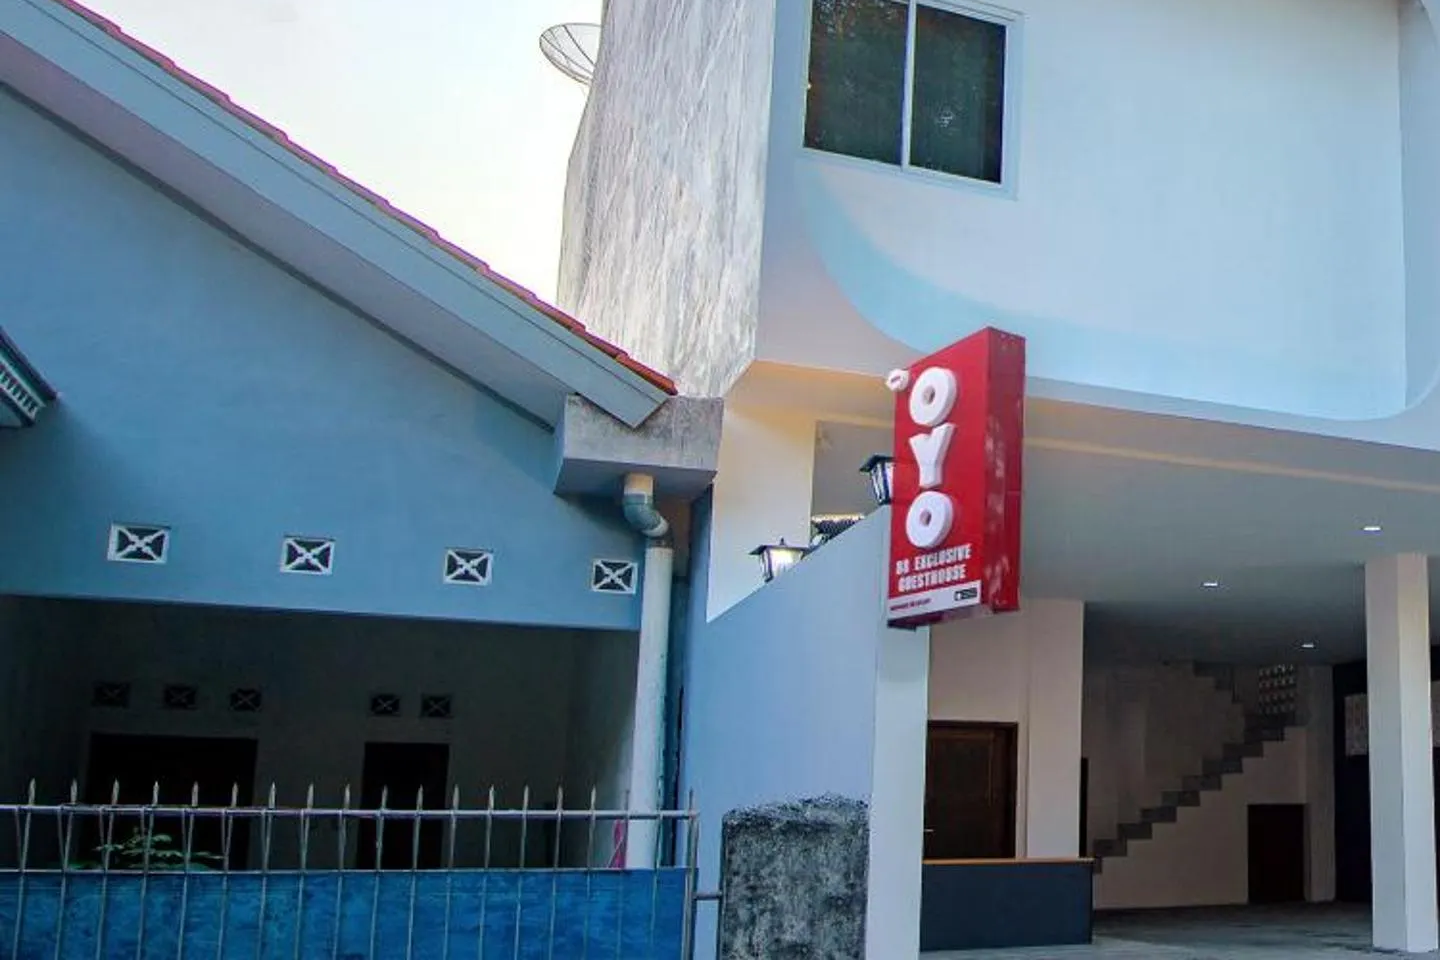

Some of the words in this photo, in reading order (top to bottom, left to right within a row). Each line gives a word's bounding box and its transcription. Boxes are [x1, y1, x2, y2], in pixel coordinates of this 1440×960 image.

[906, 367, 957, 548] OYO
[914, 543, 972, 571] EXCLUSIVE
[898, 563, 967, 593] GUESTHOUSE
